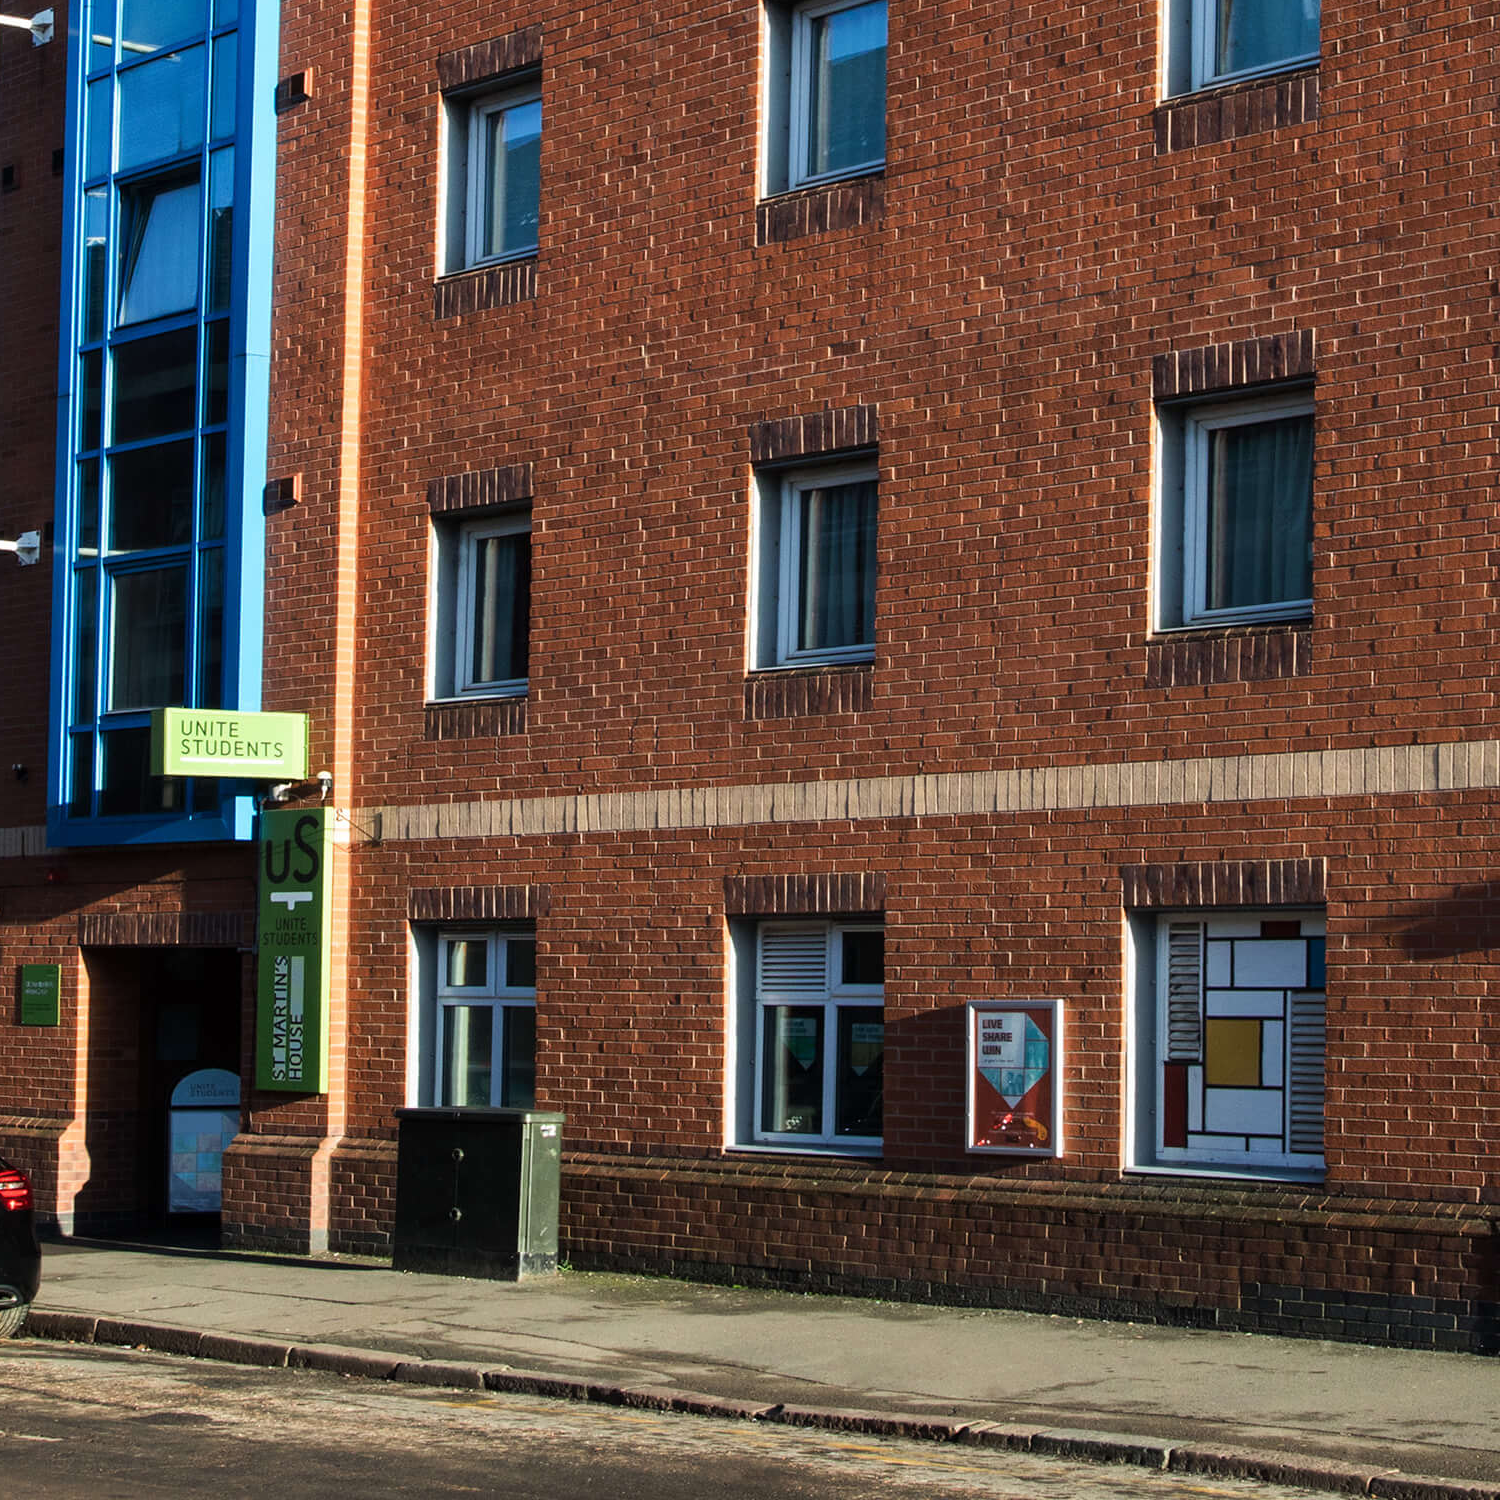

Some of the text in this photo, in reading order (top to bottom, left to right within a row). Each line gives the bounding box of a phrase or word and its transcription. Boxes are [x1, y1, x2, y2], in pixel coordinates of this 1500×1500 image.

[181, 720, 239, 738] UNITE
[180, 739, 283, 758] STUDENTS
[275, 917, 307, 931] UNITE
[263, 932, 318, 946] STUDENTS
[272, 955, 289, 1081] ST MARTIN'S
[982, 1019, 1003, 1029] LIVE
[982, 1032, 1013, 1043] SHARE
[288, 1014, 304, 1081] HOUSE
